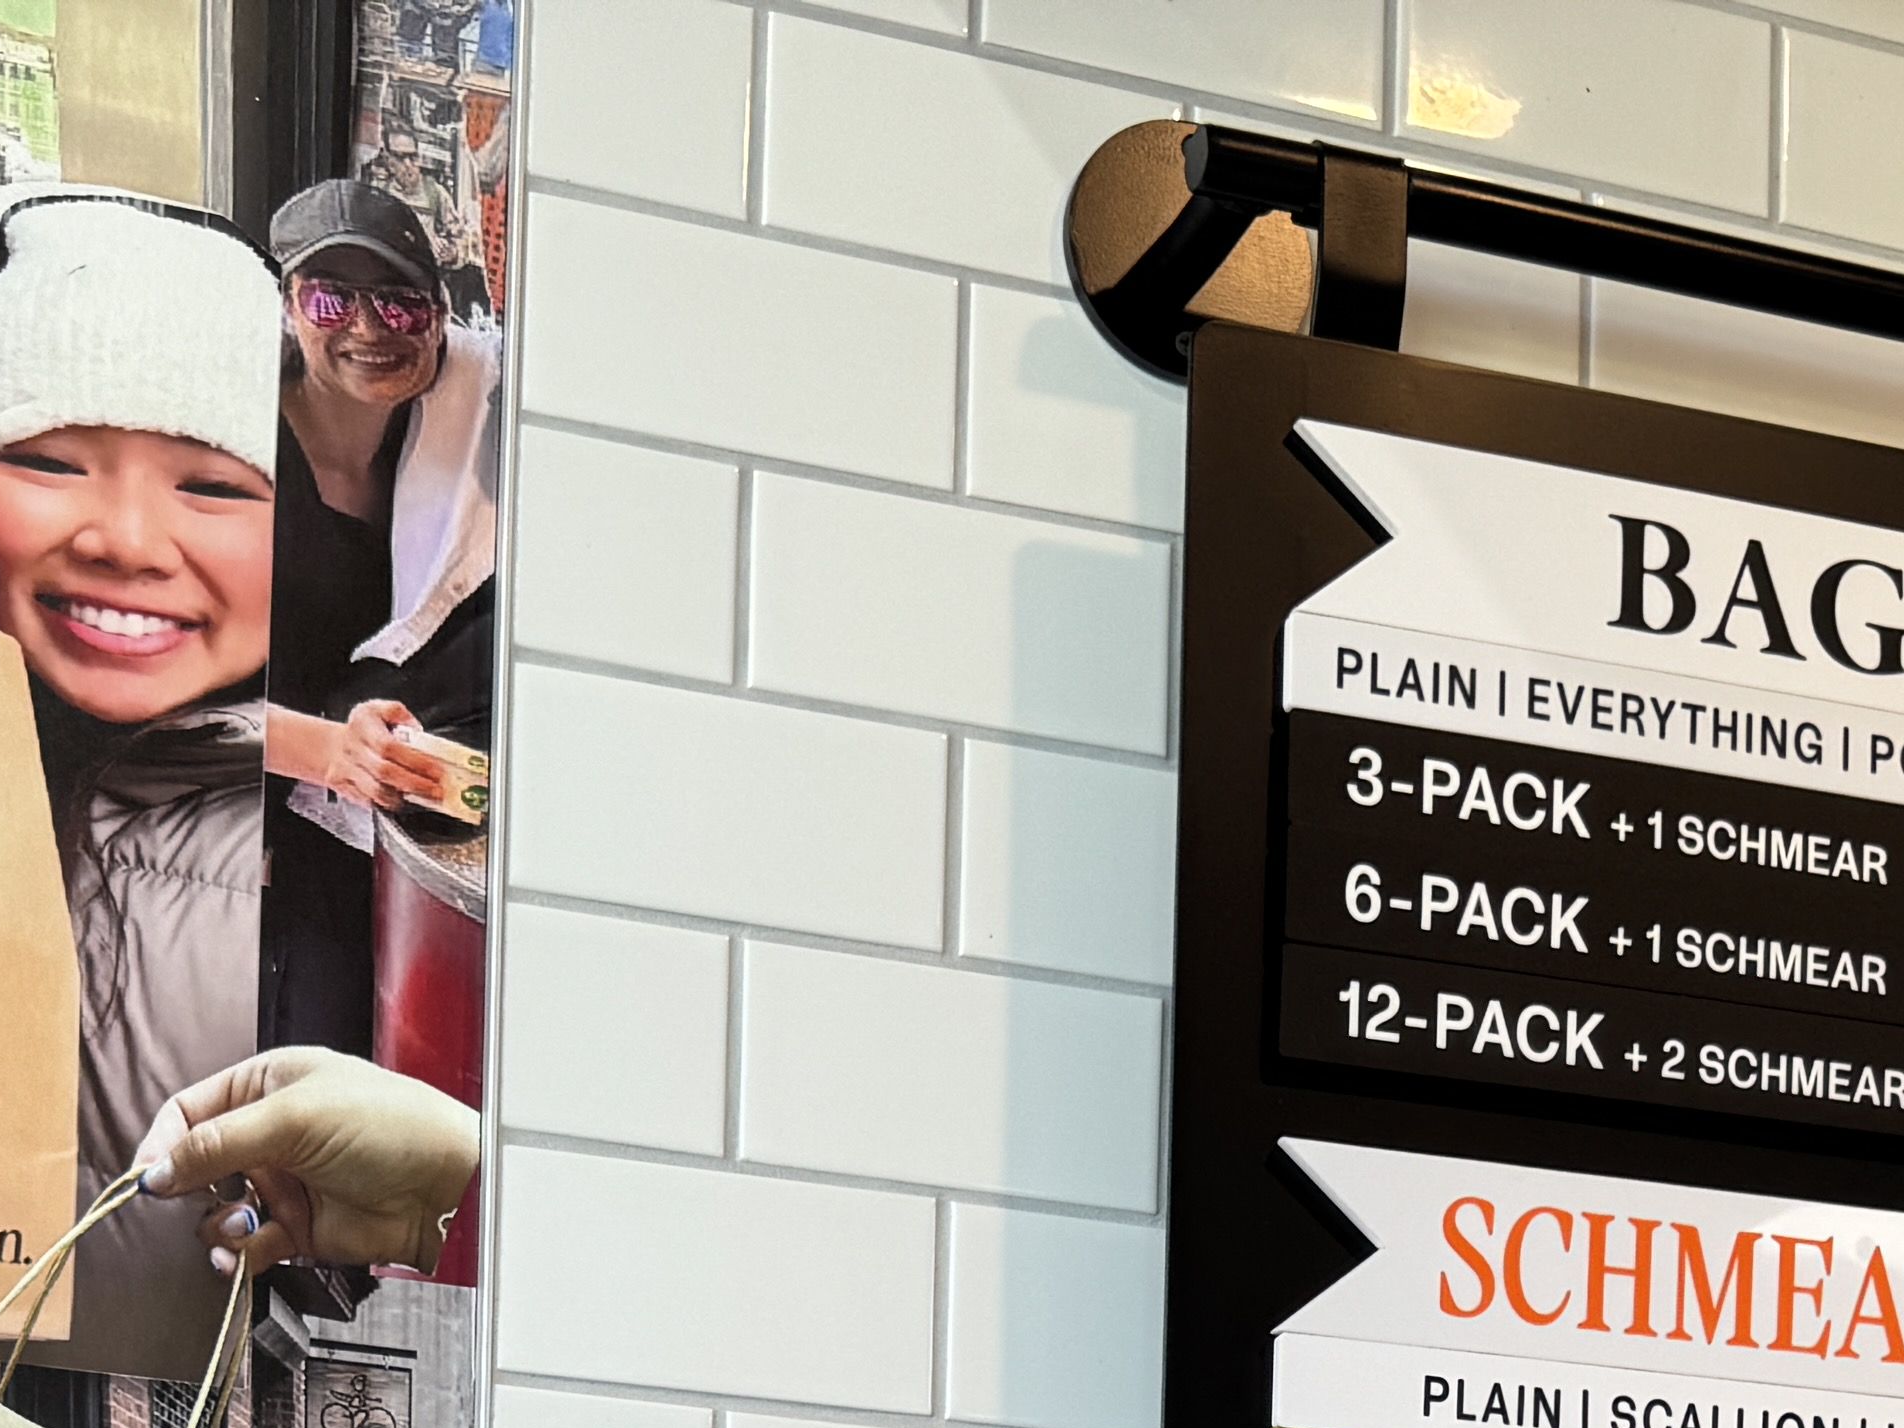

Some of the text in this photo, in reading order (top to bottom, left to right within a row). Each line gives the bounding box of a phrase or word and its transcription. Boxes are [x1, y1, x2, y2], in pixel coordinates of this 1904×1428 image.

[1336, 646, 1477, 710] PLAIN
[1527, 677, 1823, 765] EVERYTHING
[1346, 747, 1591, 839] 3-PACK
[1677, 815, 1888, 885] SCHMEAR
[1345, 863, 1589, 954] 6-PACK
[1675, 928, 1887, 996] SCHMEAR
[1339, 980, 1605, 1070] 12-PACK
